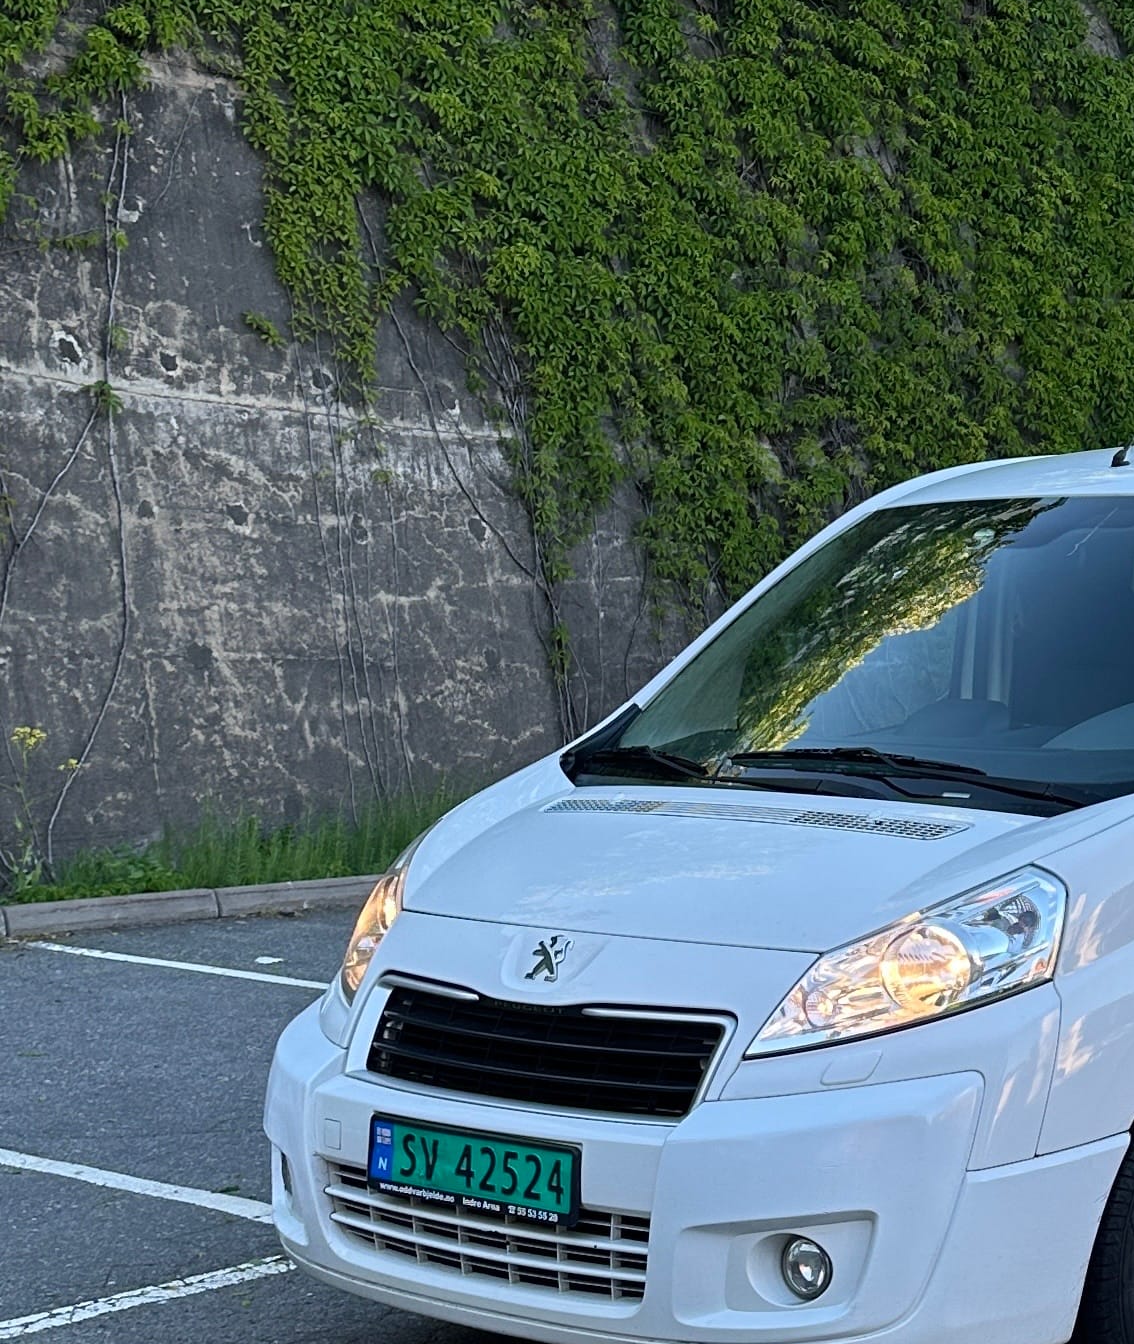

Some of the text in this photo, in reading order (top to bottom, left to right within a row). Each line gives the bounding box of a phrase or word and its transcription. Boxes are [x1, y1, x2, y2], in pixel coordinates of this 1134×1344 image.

[377, 1157, 388, 1171] N
[400, 1133, 564, 1205] SV 42524
